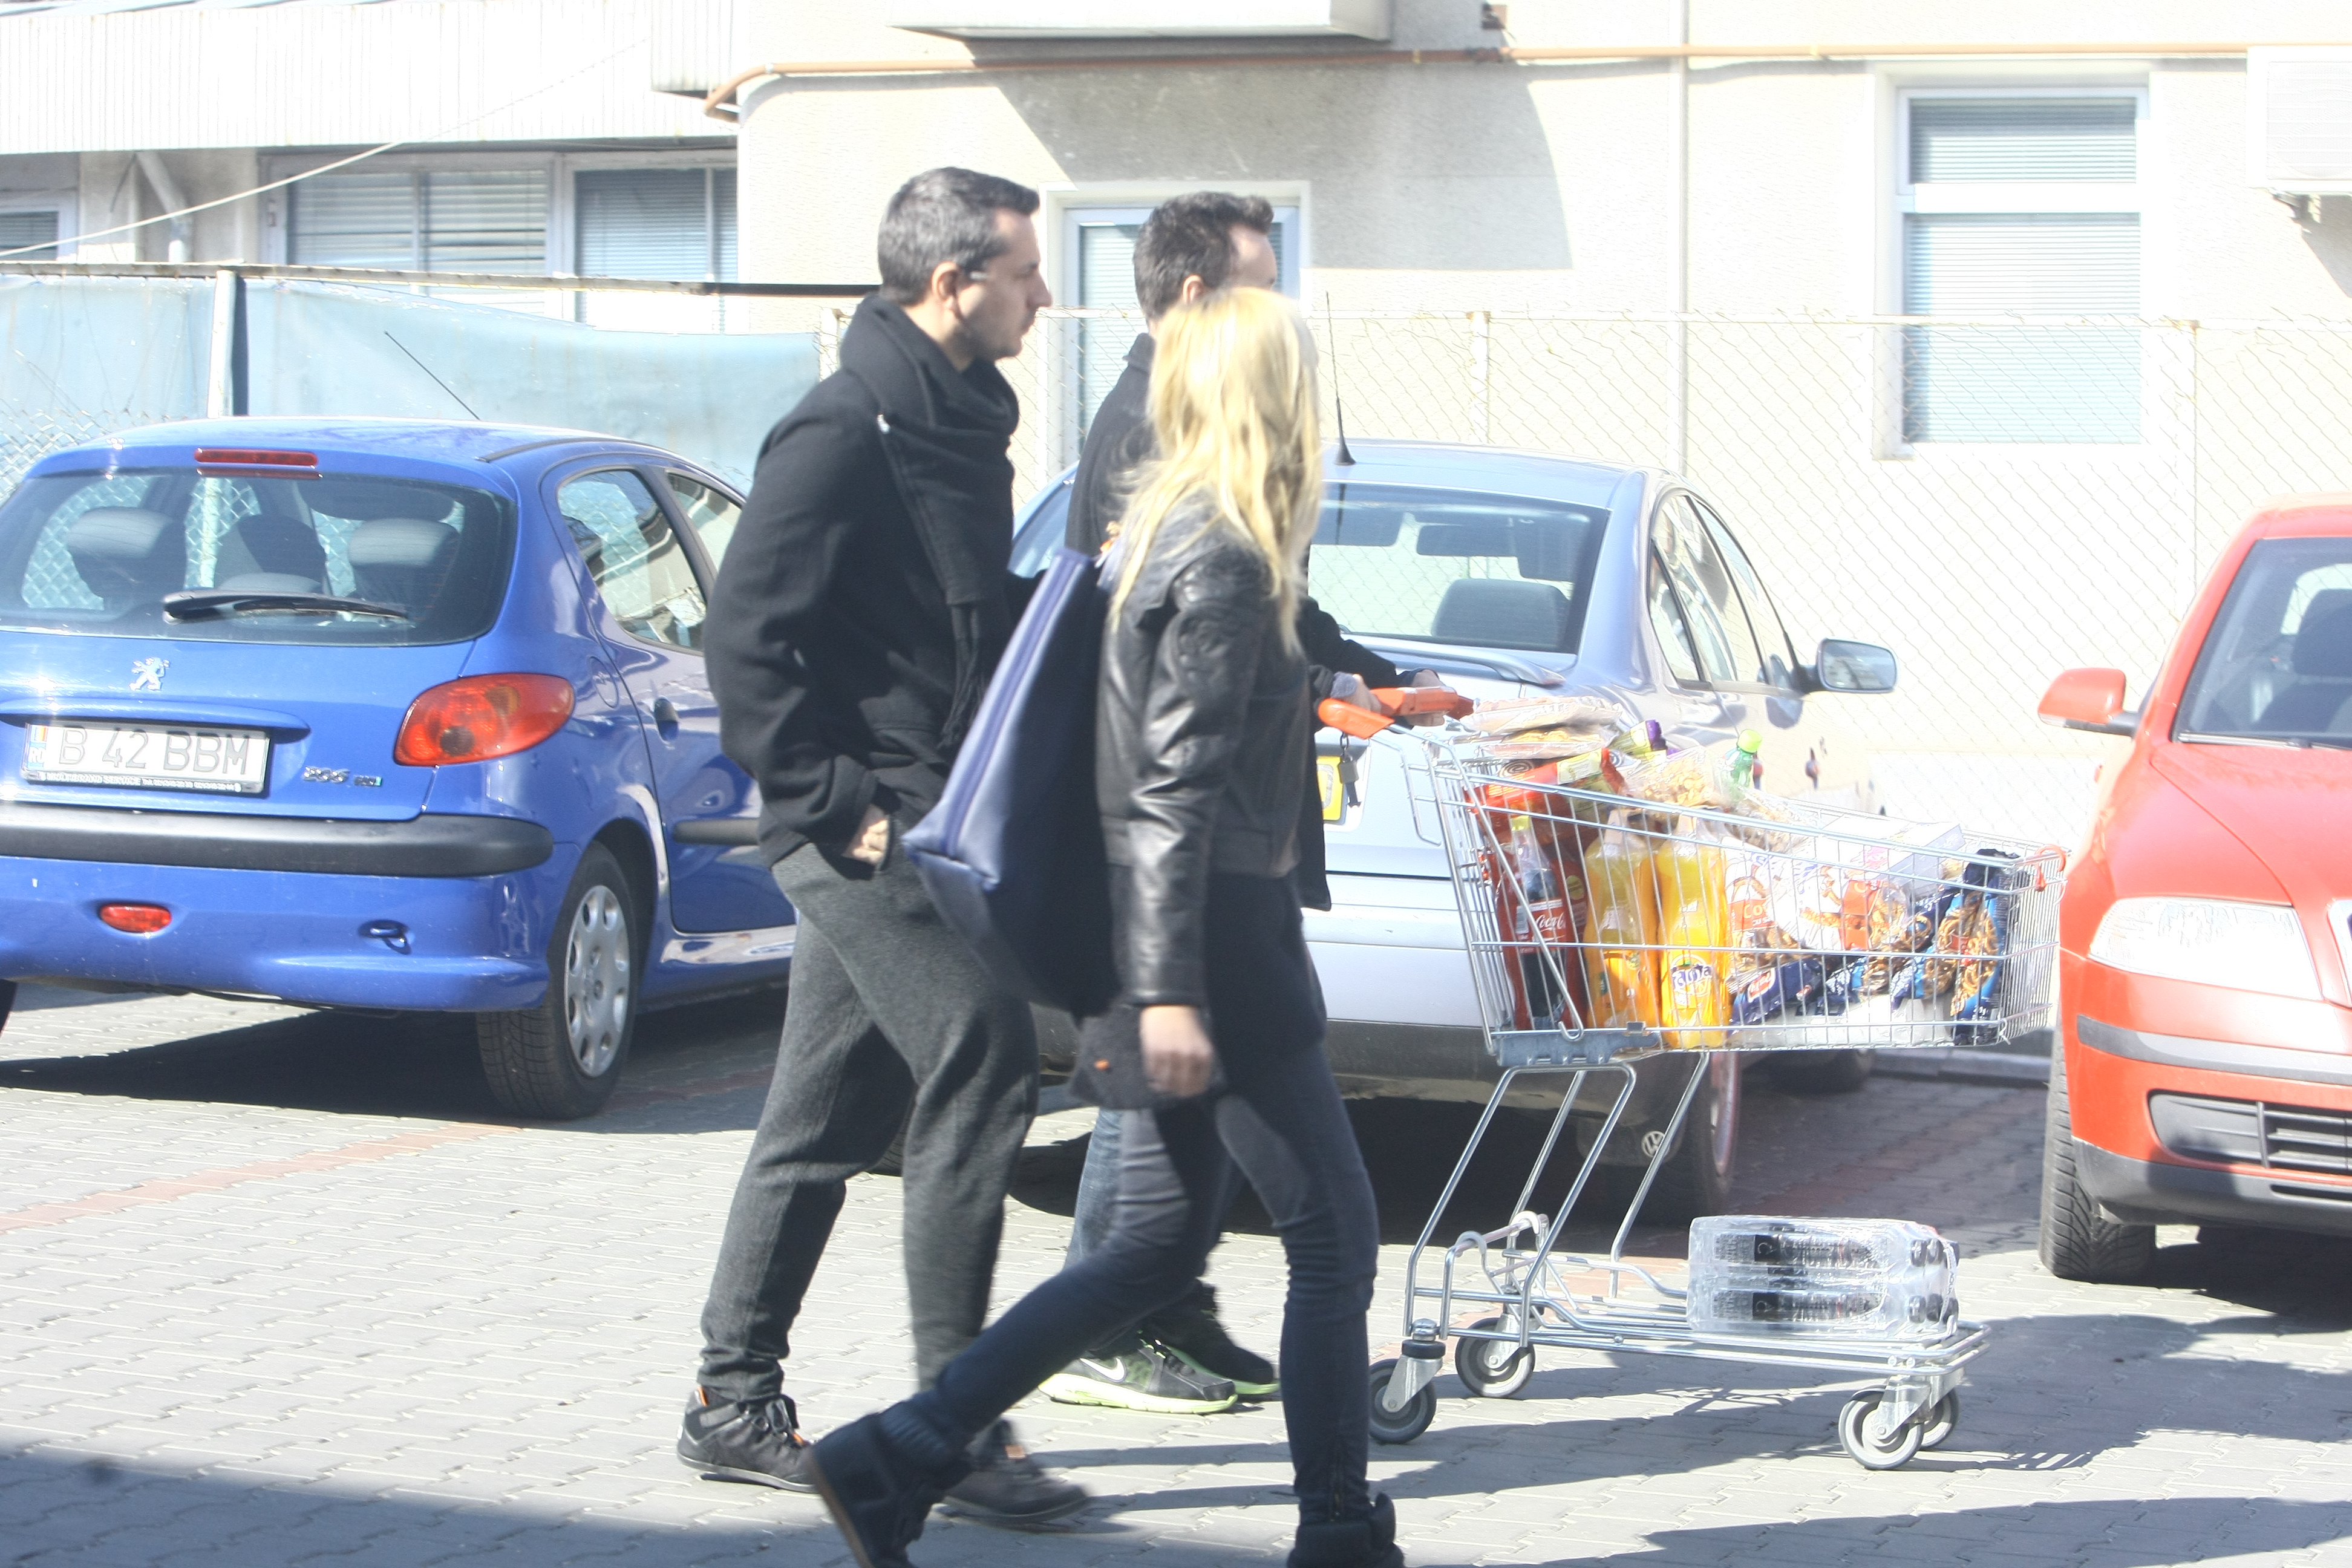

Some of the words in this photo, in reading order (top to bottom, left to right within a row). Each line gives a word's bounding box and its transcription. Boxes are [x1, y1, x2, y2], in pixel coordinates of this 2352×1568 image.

[59, 726, 87, 765] B
[102, 727, 149, 769] 42
[163, 731, 249, 775] BBM
